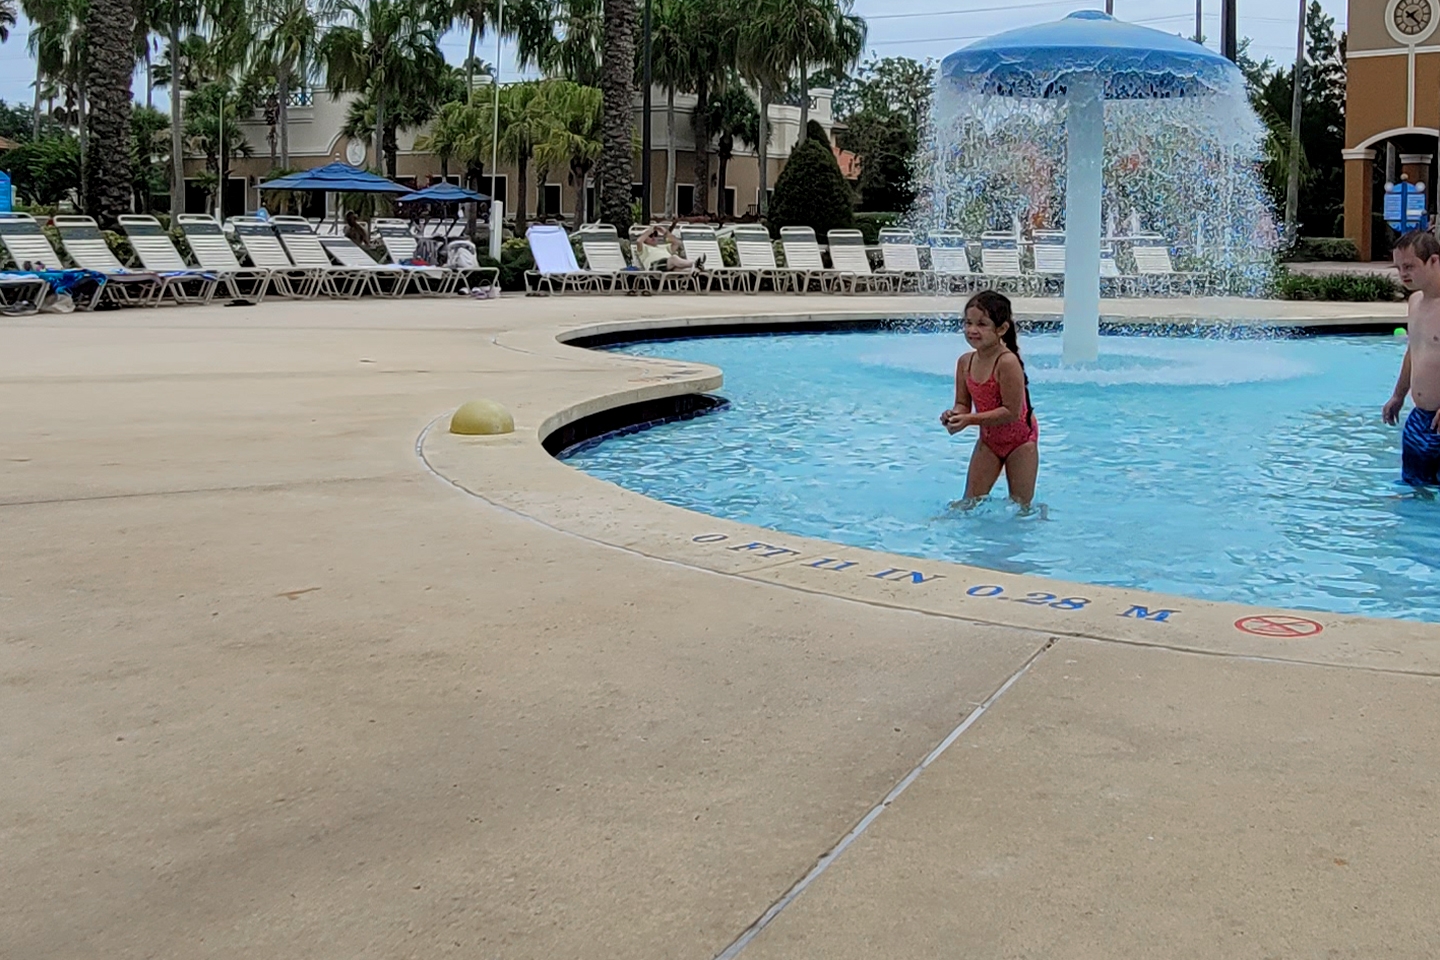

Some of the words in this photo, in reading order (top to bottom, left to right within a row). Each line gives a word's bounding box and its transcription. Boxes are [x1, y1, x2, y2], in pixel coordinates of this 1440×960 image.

[692, 534, 729, 543] 0
[726, 541, 801, 558] FT
[866, 567, 947, 584] IN
[966, 585, 1092, 611] 0.28
[1115, 604, 1182, 623] M
